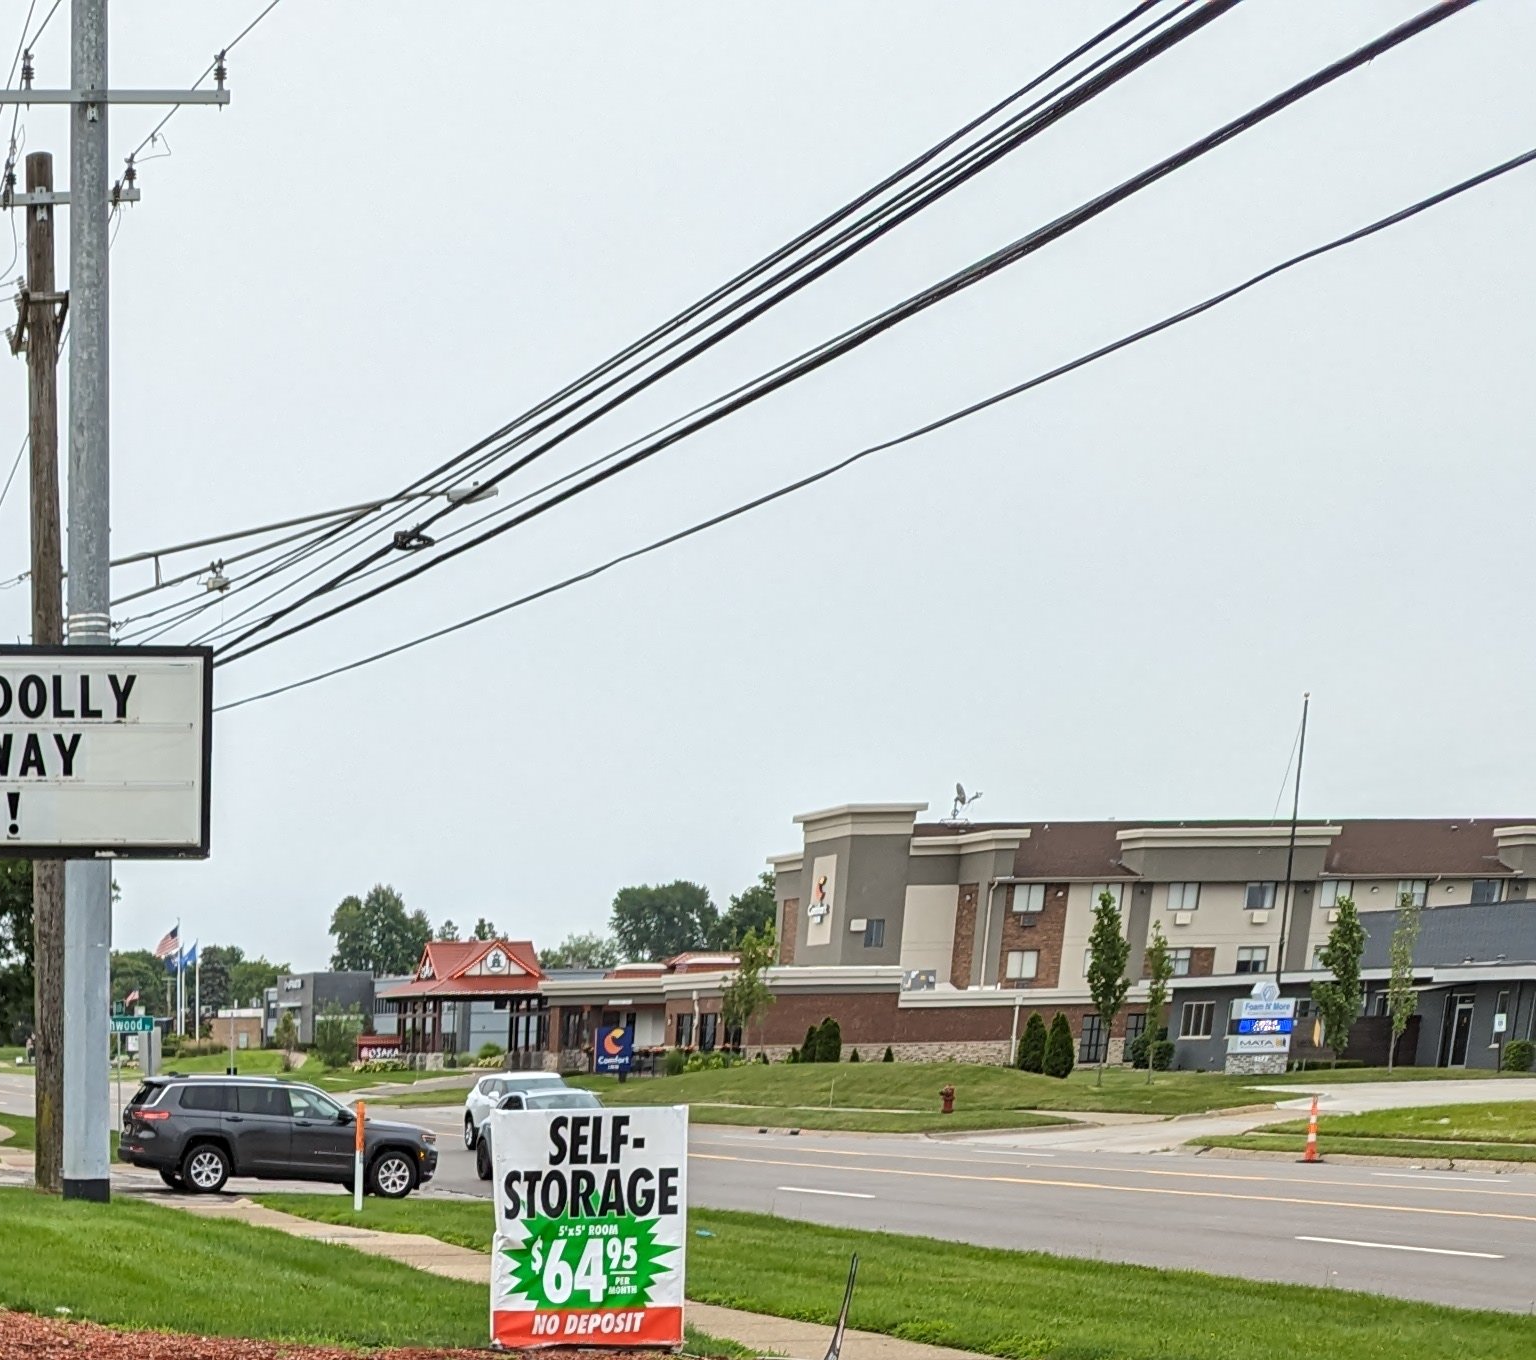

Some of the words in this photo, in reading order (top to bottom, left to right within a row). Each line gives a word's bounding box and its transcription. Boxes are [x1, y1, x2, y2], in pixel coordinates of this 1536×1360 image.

[369, 1047, 399, 1059] OSAKA
[598, 1055, 629, 1065] Comfort
[549, 1115, 645, 1166] SELF-
[504, 1167, 679, 1220] STORAGE
[588, 1224, 618, 1236] ROOM
[615, 1277, 630, 1285] PER
[608, 1285, 637, 1294] MONTH
[532, 1315, 559, 1335] NO
[564, 1312, 645, 1334] DEPOSIT
